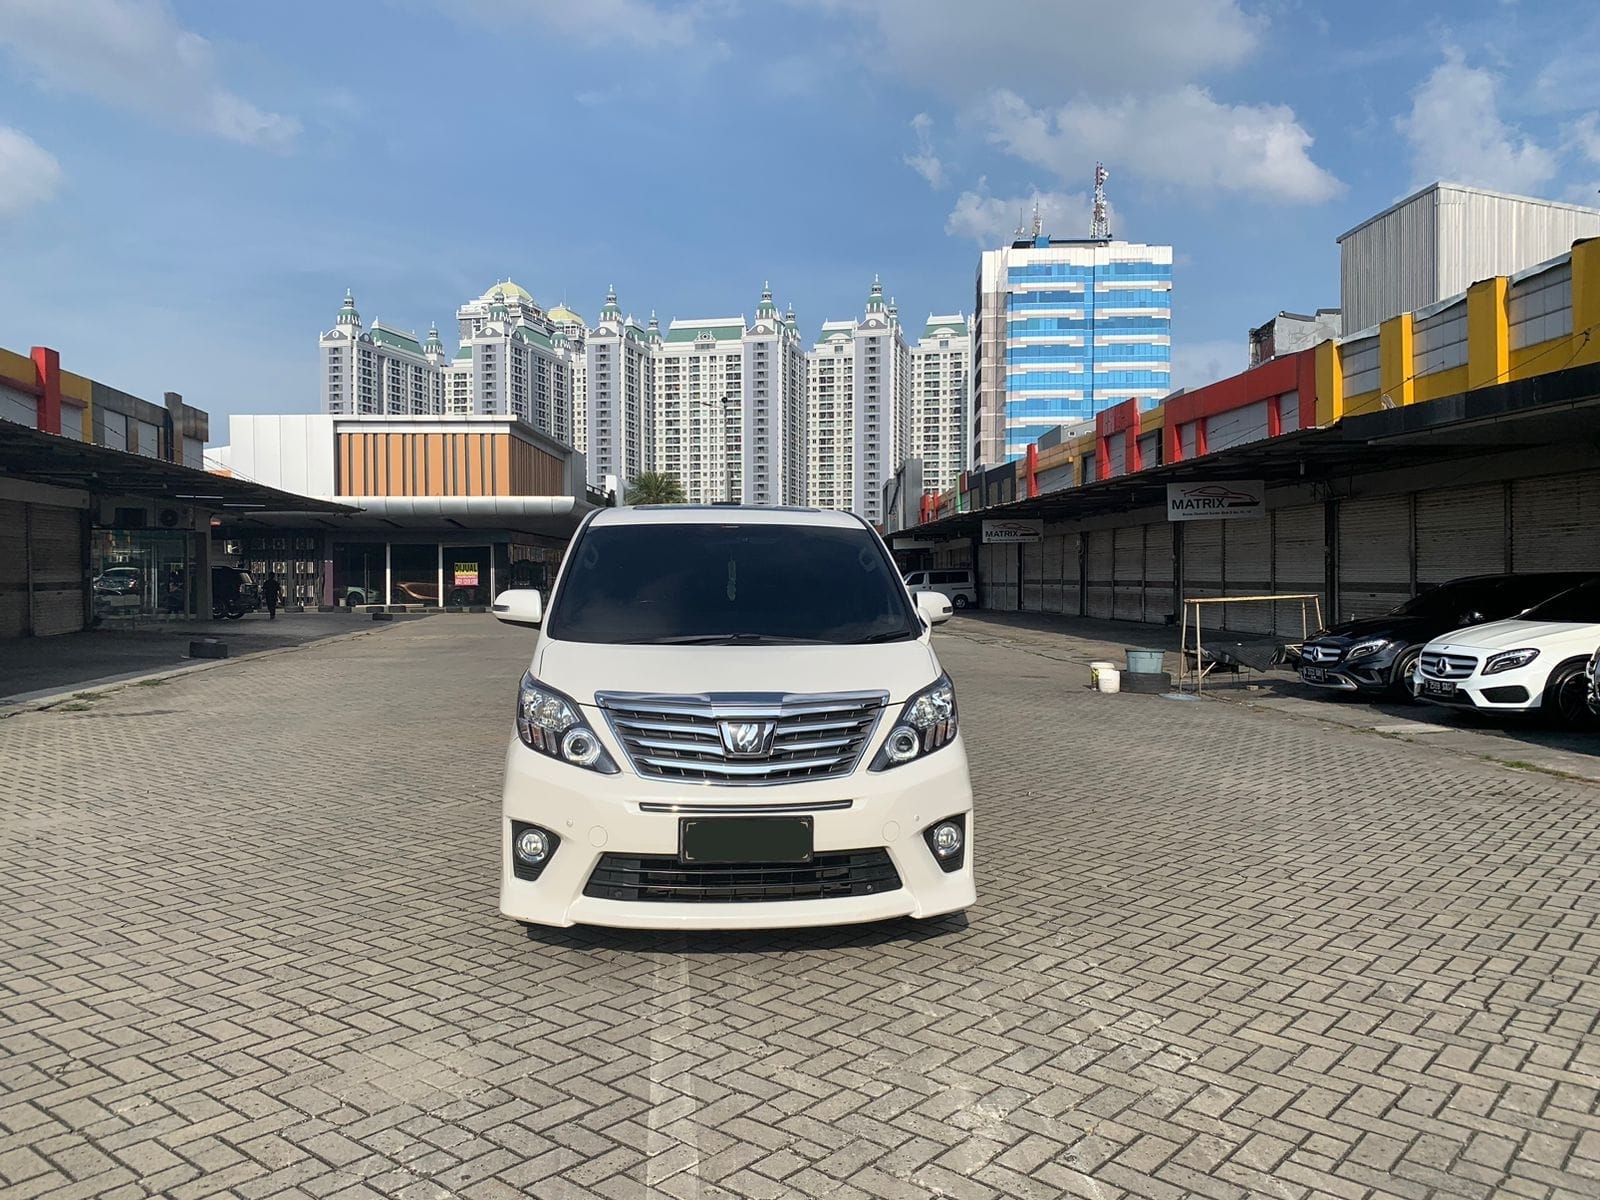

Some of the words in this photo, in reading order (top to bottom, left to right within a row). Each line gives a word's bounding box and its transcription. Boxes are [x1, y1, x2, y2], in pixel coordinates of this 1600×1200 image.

[1171, 497, 1226, 510] MATRIX
[985, 530, 1019, 538] MATRIX
[455, 563, 478, 573] DIJUAL
